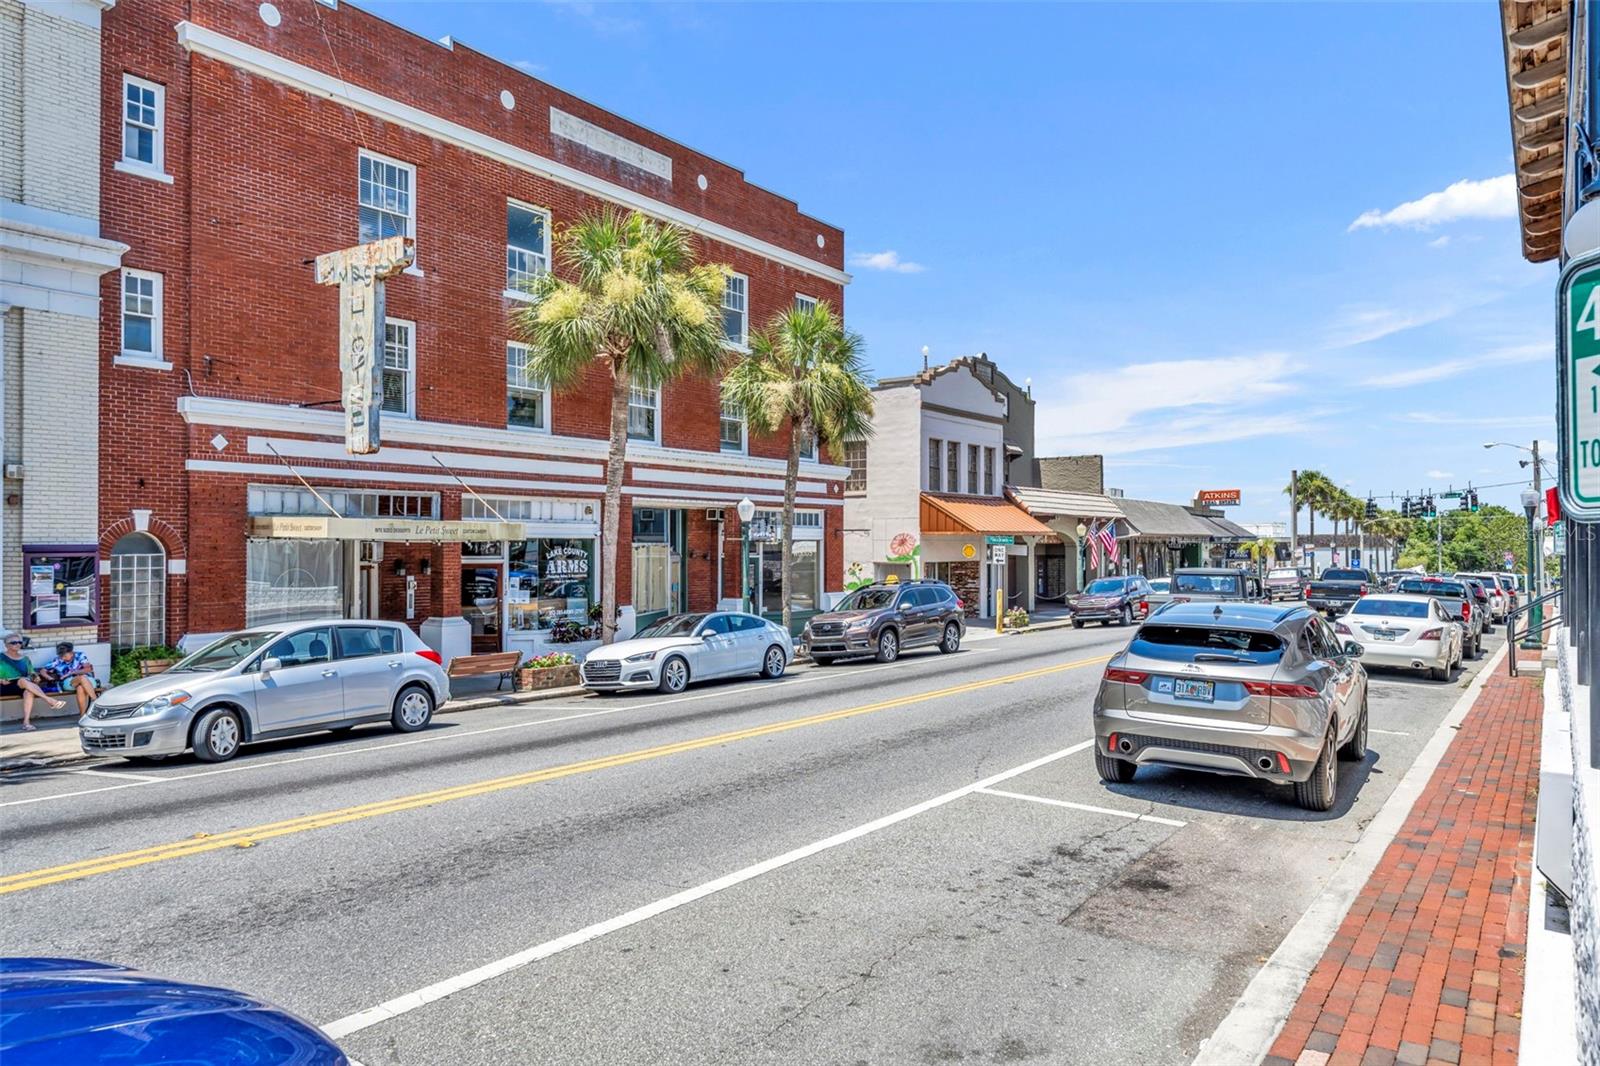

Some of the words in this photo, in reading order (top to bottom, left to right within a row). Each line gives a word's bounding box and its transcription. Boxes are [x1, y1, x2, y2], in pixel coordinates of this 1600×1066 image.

[1204, 491, 1237, 500] ATKINS
[415, 525, 424, 535] Le
[425, 525, 441, 535] Petit
[441, 525, 459, 535] Sweet
[546, 547, 562, 559] LAKE
[563, 547, 588, 558] COUNTY
[545, 559, 588, 574] ARMS
